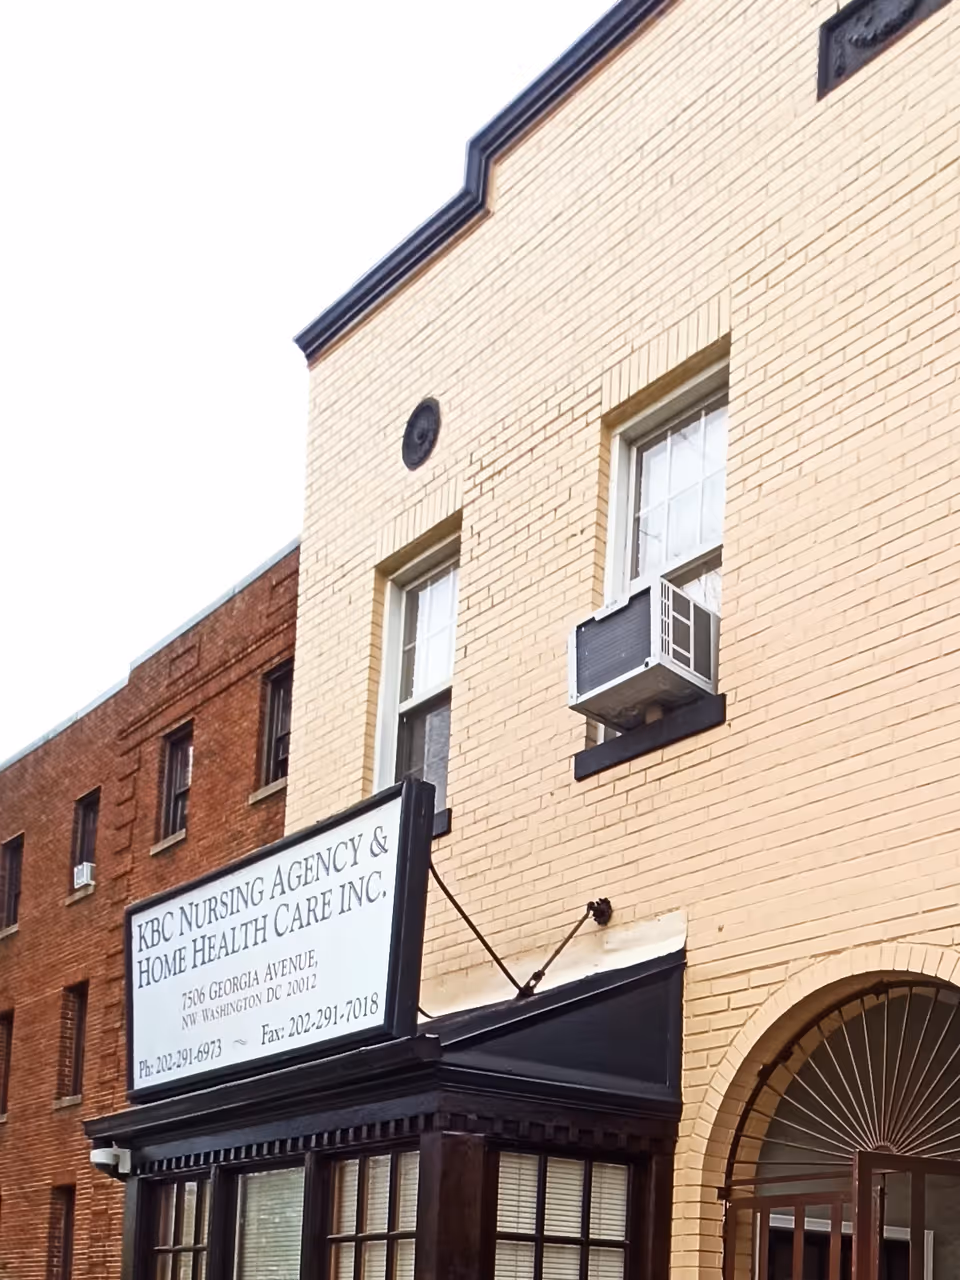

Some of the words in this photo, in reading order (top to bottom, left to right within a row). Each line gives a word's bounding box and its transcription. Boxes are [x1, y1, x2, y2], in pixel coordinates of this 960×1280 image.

[137, 911, 174, 953] KBC
[179, 876, 264, 937] NURSING
[270, 833, 363, 901] AGENCY
[370, 826, 389, 858] &
[137, 946, 187, 989] HOME
[191, 914, 269, 970] HEALTH
[273, 888, 333, 938] CARE
[338, 870, 388, 916] INC.
[182, 985, 205, 1011] 7506
[209, 970, 260, 1001] GEORGIA
[264, 949, 318, 983] AVENUE,
[201, 992, 263, 1023] WASHINGTON
[266, 984, 283, 1003] DC
[287, 973, 317, 997] 20012
[139, 1060, 154, 1079] Ph:
[155, 1038, 223, 1074] 202-291-6973
[261, 1023, 285, 1046] Fax:
[288, 991, 379, 1038] 202-291-7018
